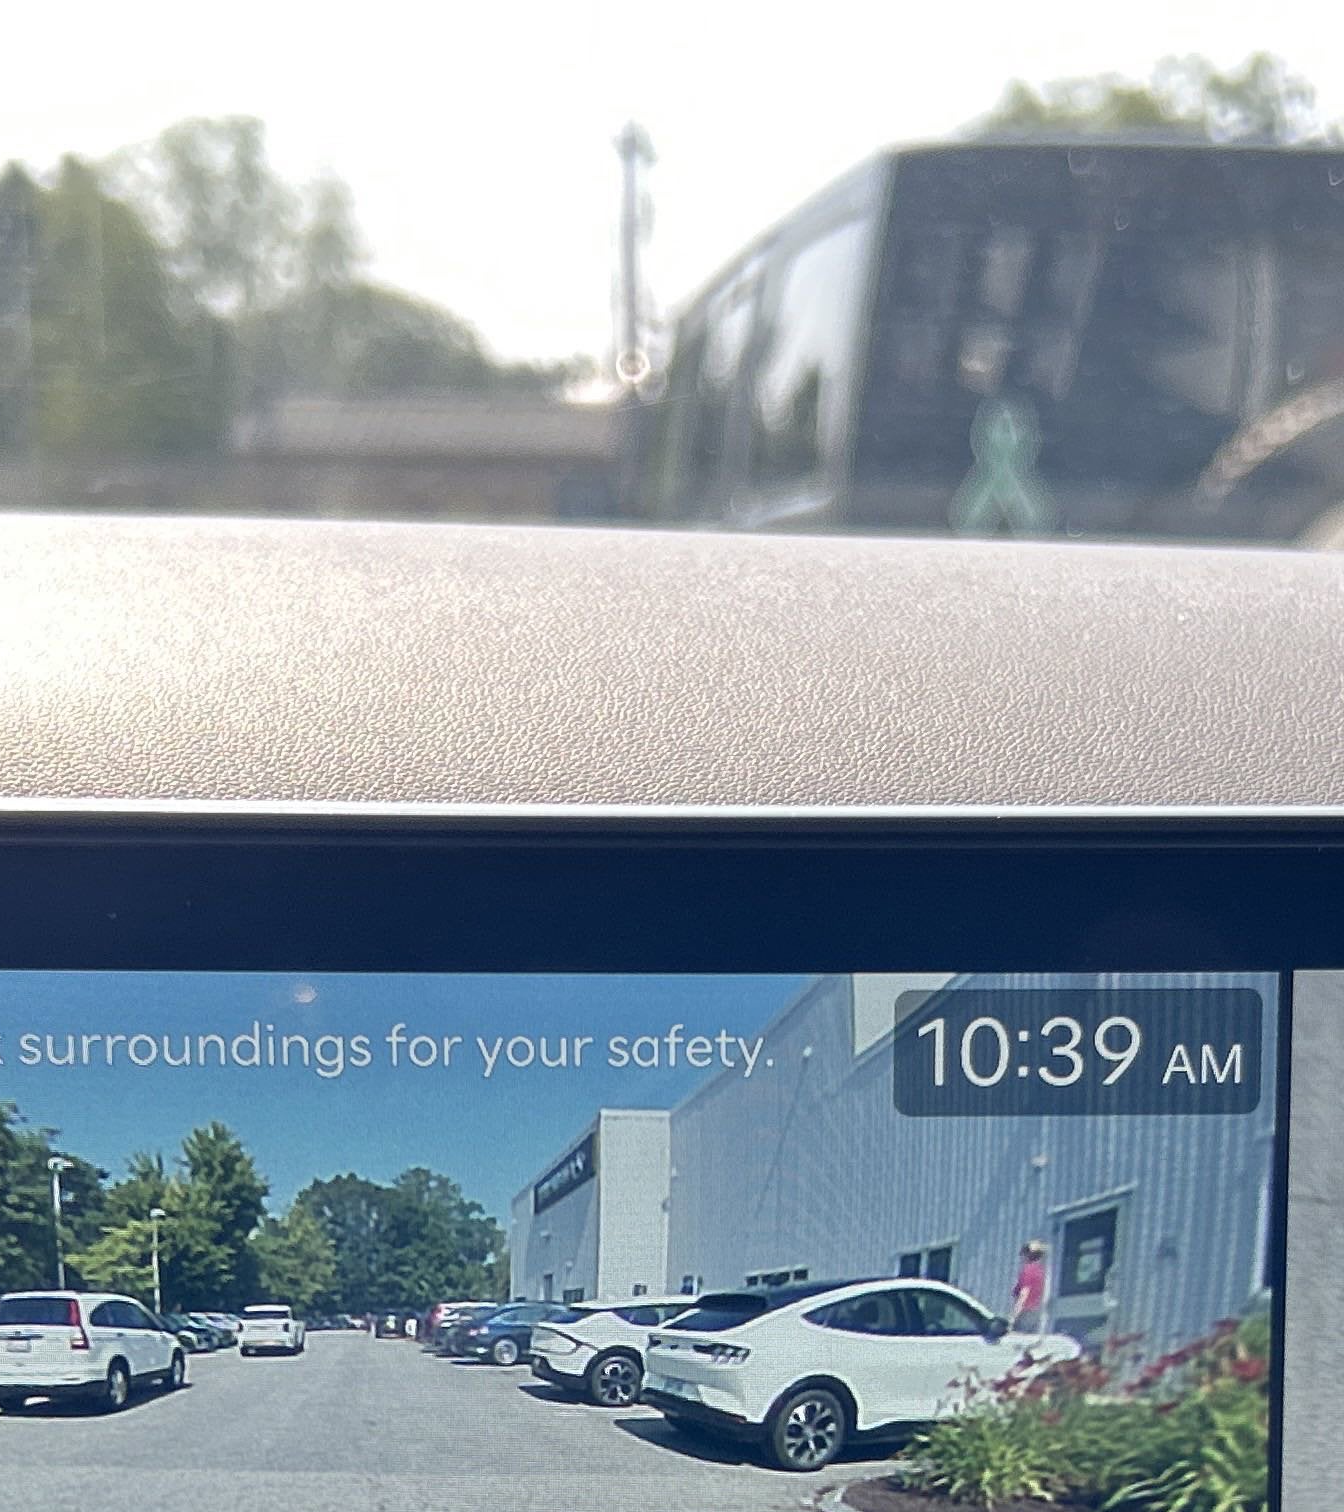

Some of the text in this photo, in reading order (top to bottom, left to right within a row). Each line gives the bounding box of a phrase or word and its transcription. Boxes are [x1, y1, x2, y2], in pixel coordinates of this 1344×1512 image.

[18, 1022, 372, 1078] surroundings
[386, 1023, 462, 1067] for
[477, 1034, 594, 1077] your
[607, 1023, 775, 1077] safety.
[917, 1016, 1243, 1087] 10:39 AM
